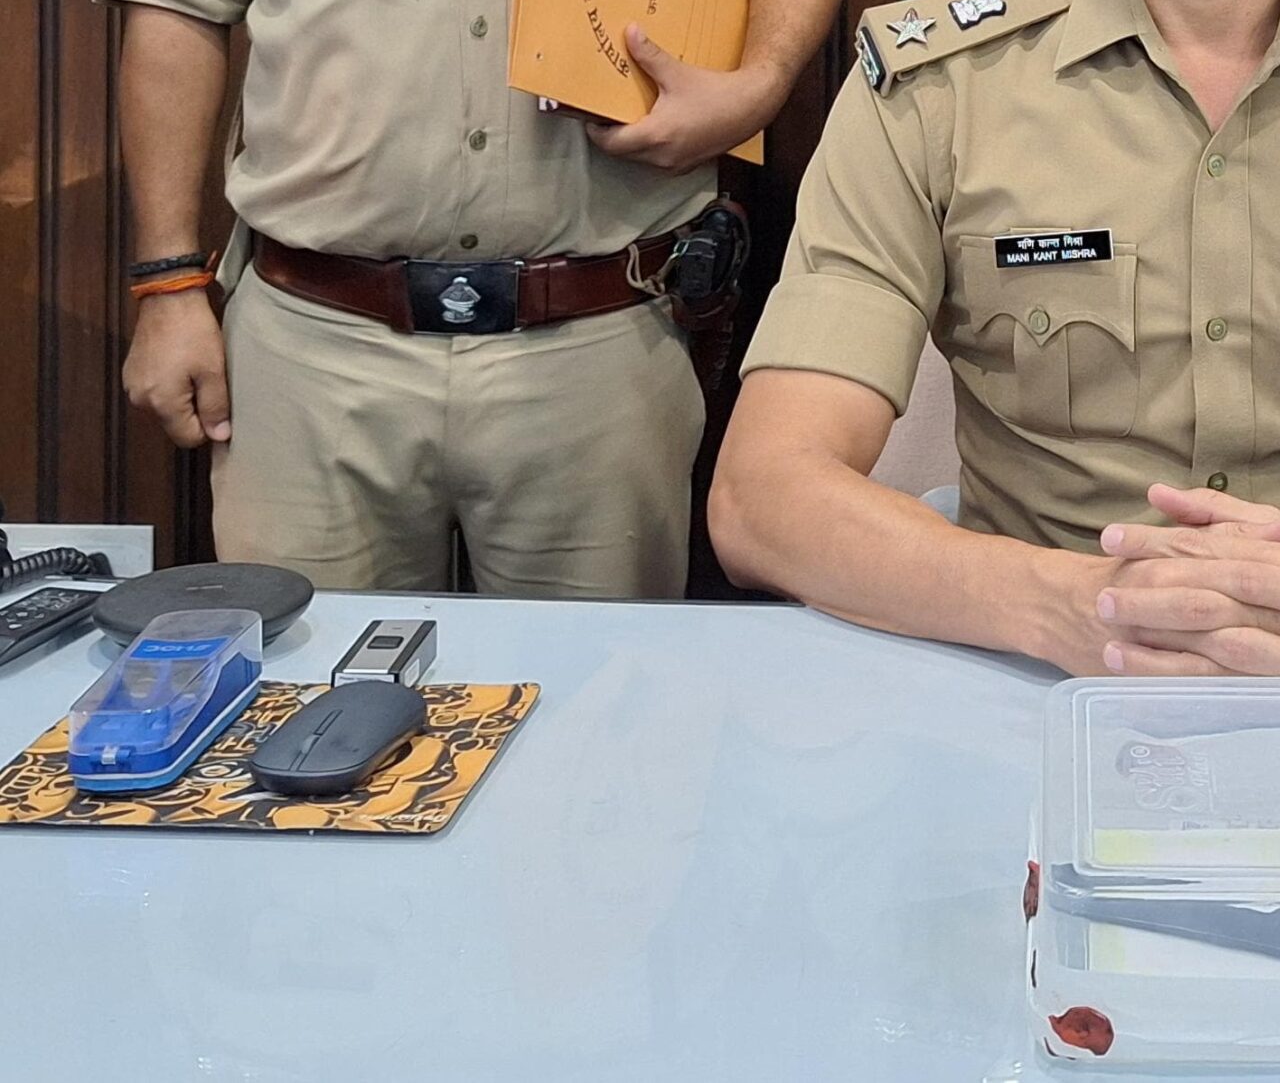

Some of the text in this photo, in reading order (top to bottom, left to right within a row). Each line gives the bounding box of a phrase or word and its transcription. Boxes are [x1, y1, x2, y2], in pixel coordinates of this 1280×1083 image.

[587, 7, 629, 78] कार्यालय
[1006, 248, 1097, 264] MANI KANT MISHRA
